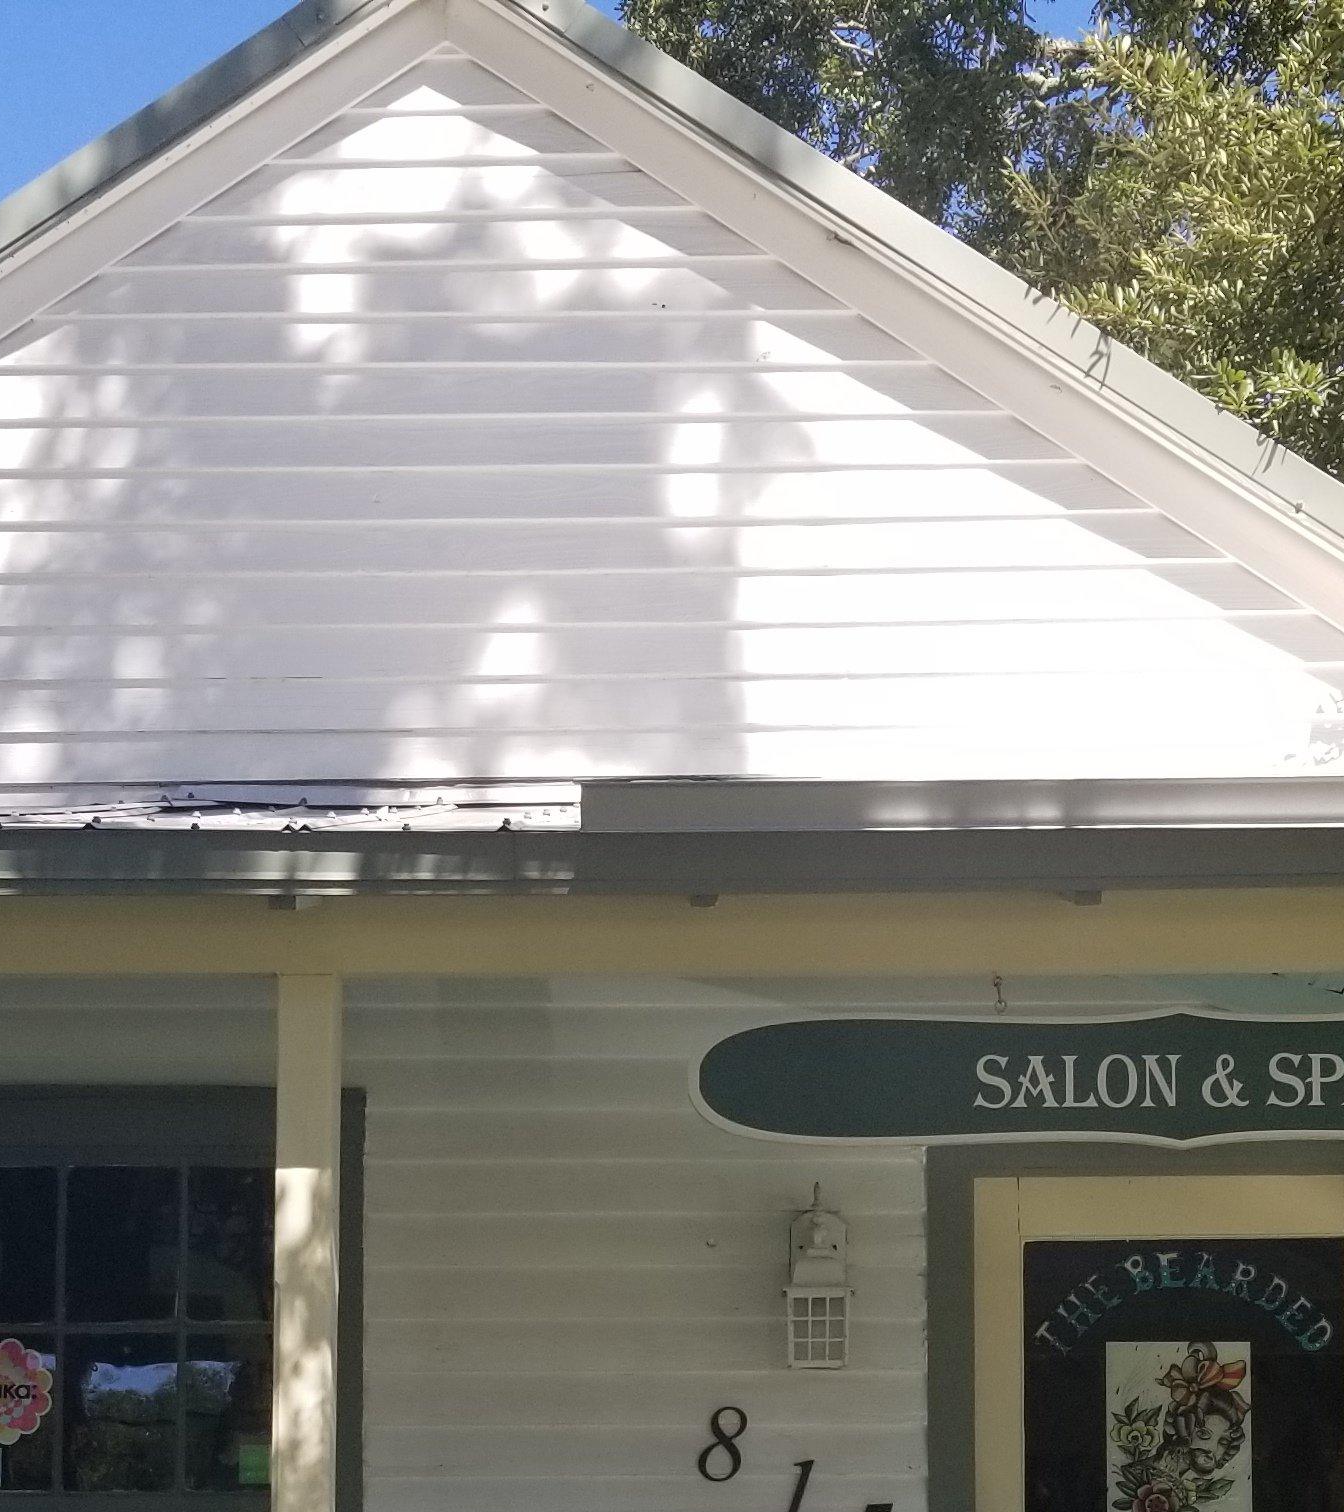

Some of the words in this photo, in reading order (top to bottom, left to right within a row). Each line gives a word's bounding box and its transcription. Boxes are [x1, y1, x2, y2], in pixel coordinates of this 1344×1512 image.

[973, 1052, 1184, 1109] SALON
[1201, 1052, 1251, 1109] &
[1033, 1274, 1123, 1356] THE
[1116, 1251, 1335, 1353] BEARDED
